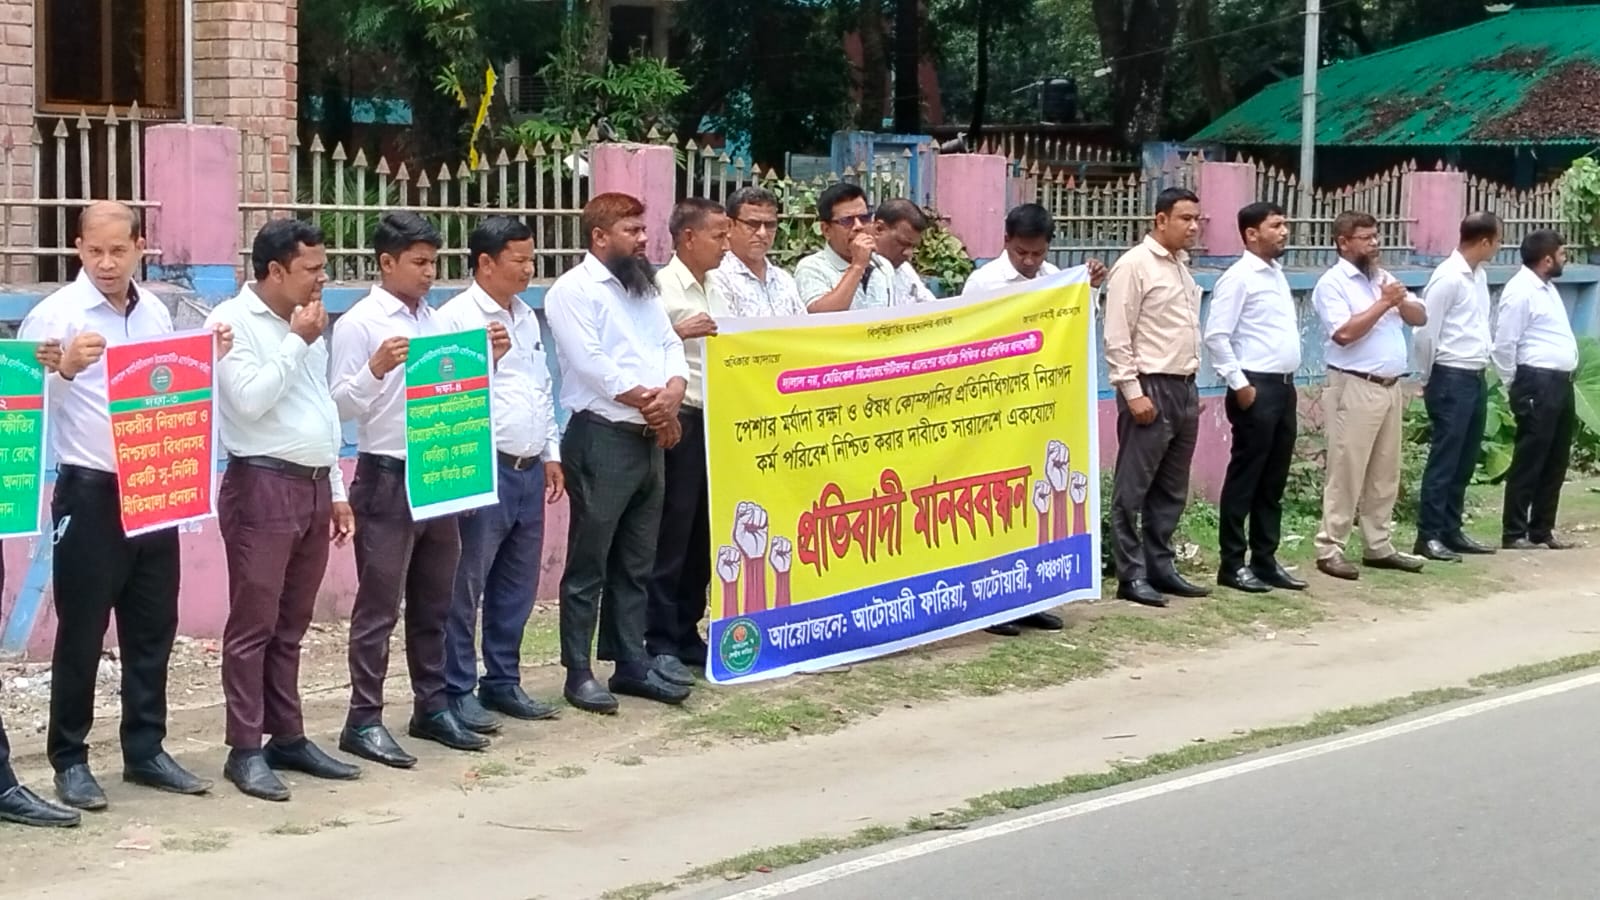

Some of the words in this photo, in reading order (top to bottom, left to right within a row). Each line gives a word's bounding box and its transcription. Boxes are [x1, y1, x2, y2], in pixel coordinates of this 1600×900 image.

[114, 413, 154, 437] চাকরীর
[156, 410, 198, 431] নিরাপত্তা
[200, 409, 209, 422] ও
[735, 415, 778, 442] পেশার
[780, 404, 813, 434] মর্যাদা
[816, 404, 843, 428] রক্ষা
[847, 404, 857, 421] ও
[863, 393, 893, 419] ঔষধ
[895, 383, 954, 414] কোম্পানির
[1033, 364, 1073, 390] নিরাপদ
[163, 435, 206, 456] বিধানসহ
[756, 444, 780, 475] কর্ম
[783, 441, 831, 470] পরিবেশ
[832, 432, 871, 463] নিশ্চিত
[874, 428, 904, 452] করার
[908, 417, 948, 447] দাবীতে
[952, 410, 1001, 437] সারাদেশে
[1006, 400, 1057, 425] একযোগে
[127, 465, 156, 487] একটি
[122, 493, 167, 516] নীতিমালা
[798, 468, 907, 577] প্রতিবাদী
[910, 465, 1032, 549] মানববন্ধন
[851, 587, 916, 632] আটোয়ারী
[918, 579, 967, 616] ফারিয়া,
